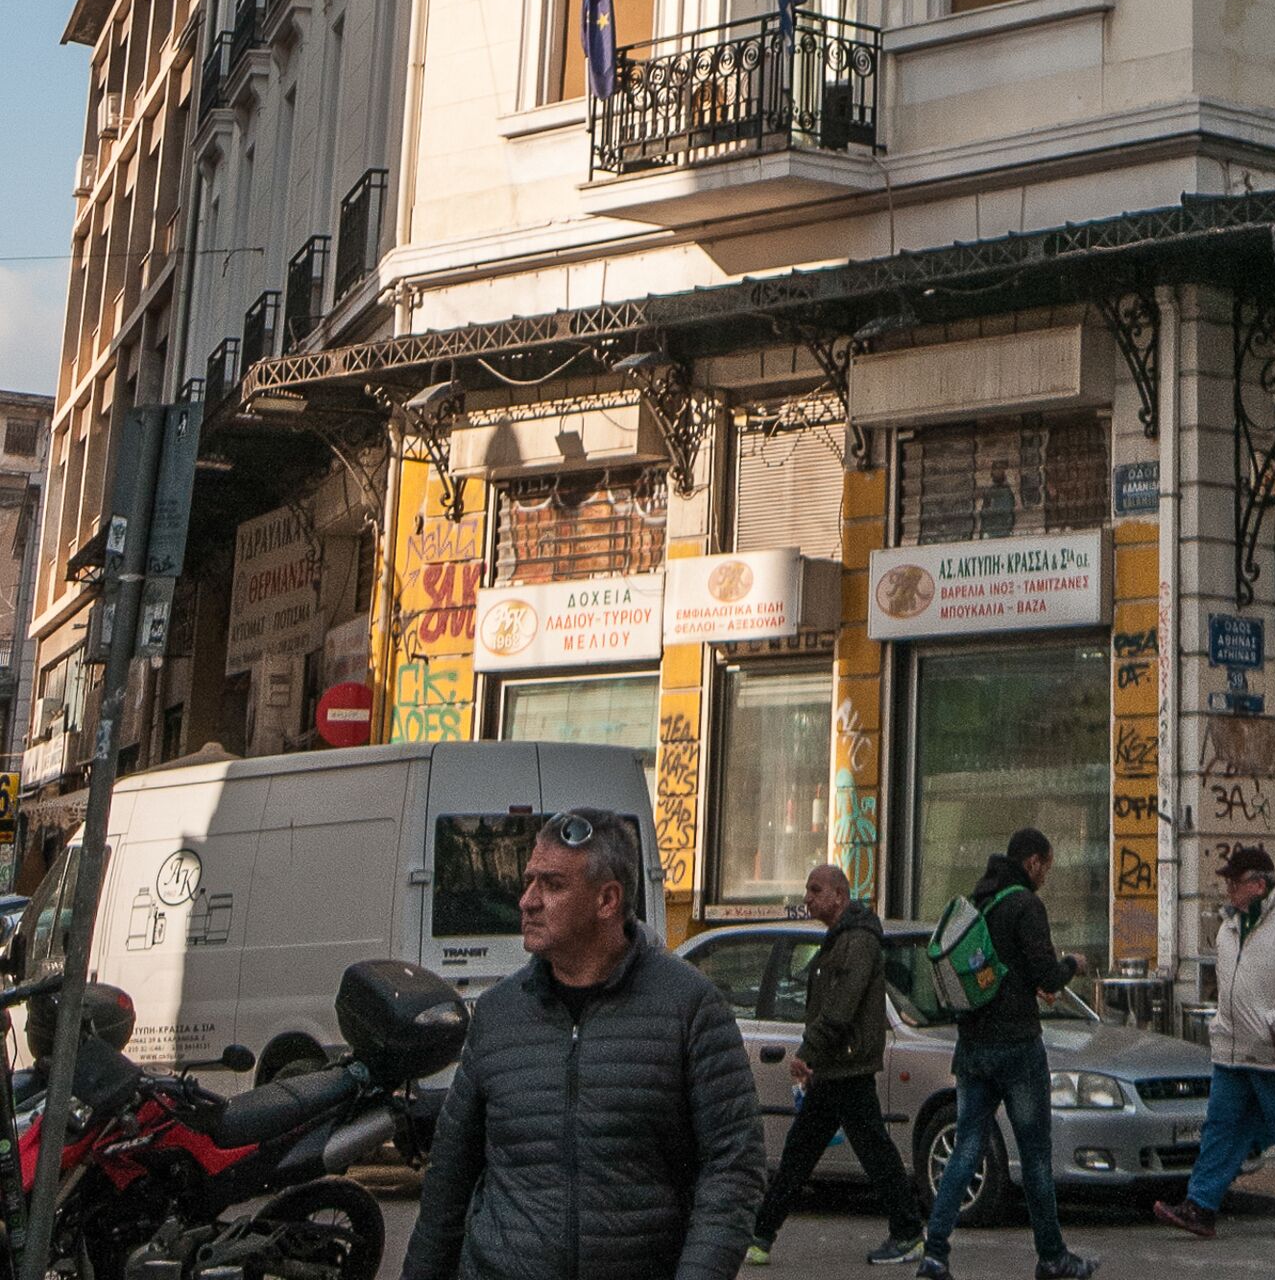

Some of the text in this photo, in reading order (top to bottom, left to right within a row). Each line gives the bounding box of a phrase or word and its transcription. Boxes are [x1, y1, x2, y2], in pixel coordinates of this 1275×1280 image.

[940, 575, 1089, 600] ΒΑΡΕΛΙΑ ΙΝΟΞ ΤΑΜΙΤΖΑΝΕΣ
[567, 589, 632, 608] ΔΟΧΕΙΑ
[676, 602, 784, 619] ΕΜΦΙΑΛΩΤΙΚΑ ΕΙΔΗ
[940, 599, 1047, 619] ΜΠΟΥΚΑΛΙΑ ΒΑΖΑ
[545, 608, 652, 631] ΛΑΔΙΟΥ-ΤΥΡΙΟΥ
[674, 616, 786, 634] ΦΕΛΛΟΙ ΑΞΕΣΟΥΑΡ
[1224, 621, 1252, 634] ΟΔΟΣ
[563, 632, 631, 651] ΜΕΛΙΟΥ
[1217, 634, 1257, 649] ΑΘΗΝΑΣ
[443, 947, 489, 957] TRANSIT
